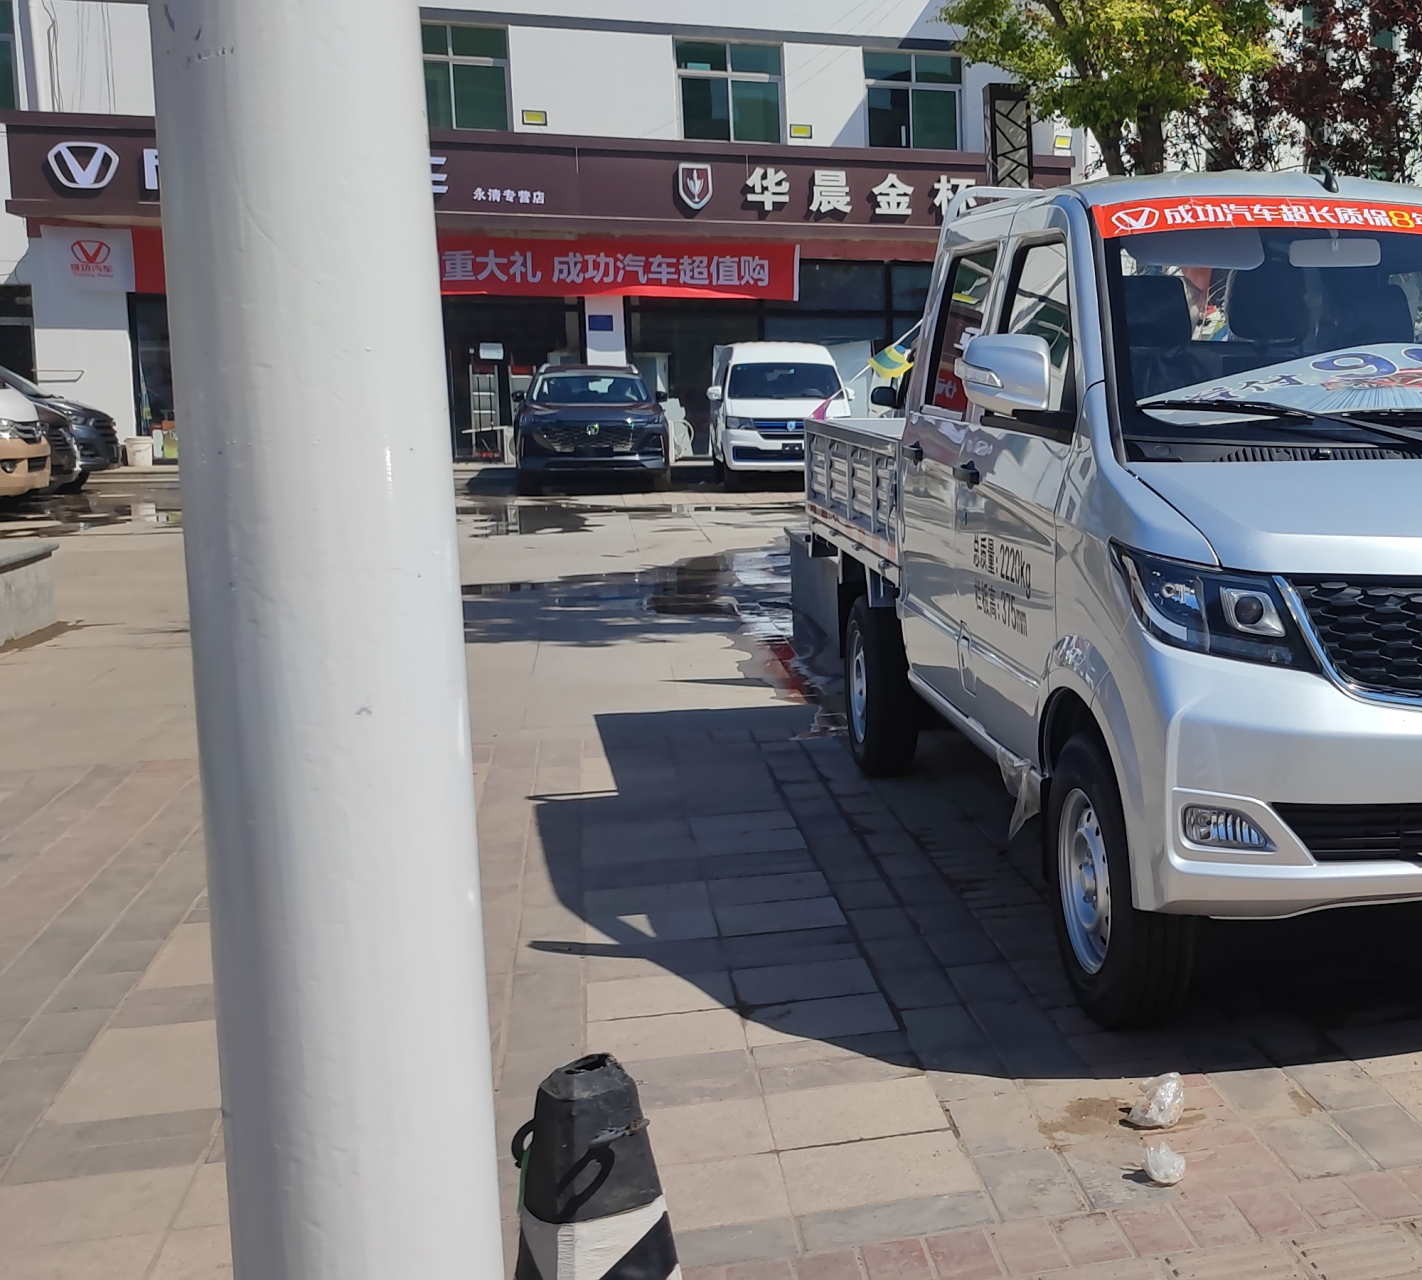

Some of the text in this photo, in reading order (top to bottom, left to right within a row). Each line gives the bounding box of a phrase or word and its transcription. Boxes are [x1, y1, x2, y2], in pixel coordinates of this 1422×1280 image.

[473, 187, 545, 204] 永清专营店
[746, 166, 977, 216] 华晨金杯
[442, 249, 769, 287] 重大礼 成功汽车超值购
